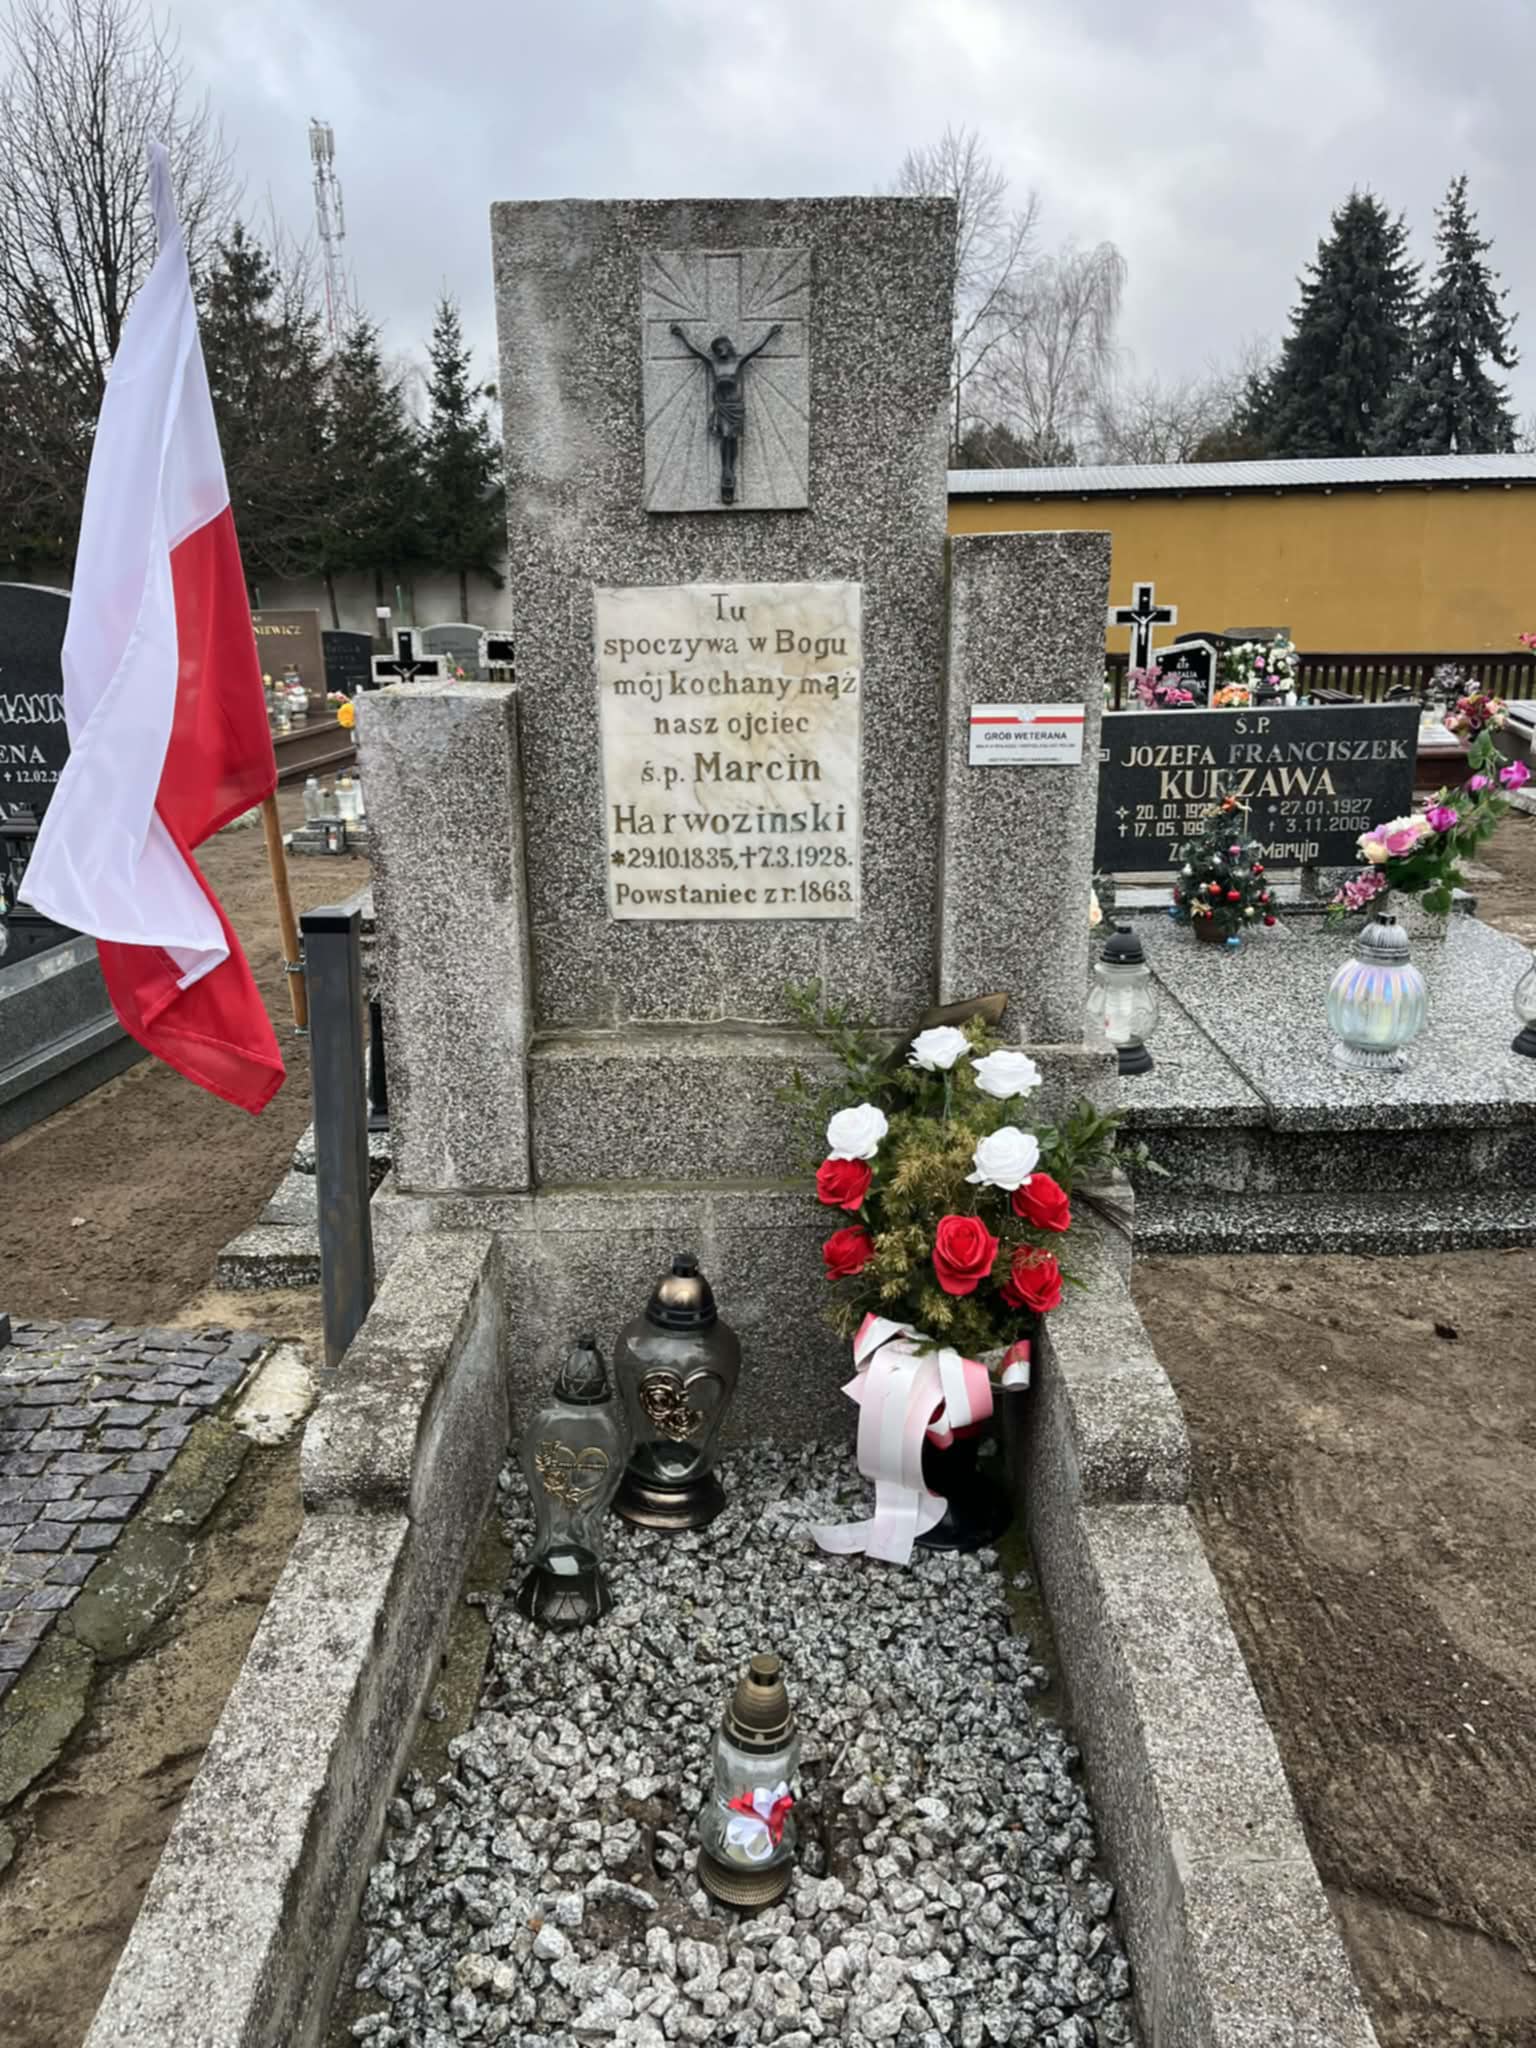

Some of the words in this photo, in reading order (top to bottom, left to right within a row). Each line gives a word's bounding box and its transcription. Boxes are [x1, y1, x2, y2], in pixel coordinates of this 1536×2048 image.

[710, 592, 747, 622] Tu
[603, 637, 739, 663] spoczywa
[748, 637, 767, 653] w
[774, 628, 848, 660] Bogu
[613, 672, 663, 702] mój
[669, 670, 791, 701] kochany
[800, 671, 857, 700] mąż
[654, 716, 719, 735] nasz
[727, 711, 809, 741] ojciec
[984, 729, 1012, 741] GRÓB
[1014, 730, 1068, 741] WETERANA
[1228, 739, 1410, 765] FRANCISZEK
[16, 770, 60, 783] 12.02.2
[640, 760, 685, 790] ś.p.
[693, 752, 822, 782] Marcin
[1159, 766, 1336, 801] KURZAWA
[1280, 798, 1373, 816] 27.01.1927
[1182, 820, 1206, 836] 199
[615, 882, 758, 906] Powstaniec
[765, 888, 777, 903] z
